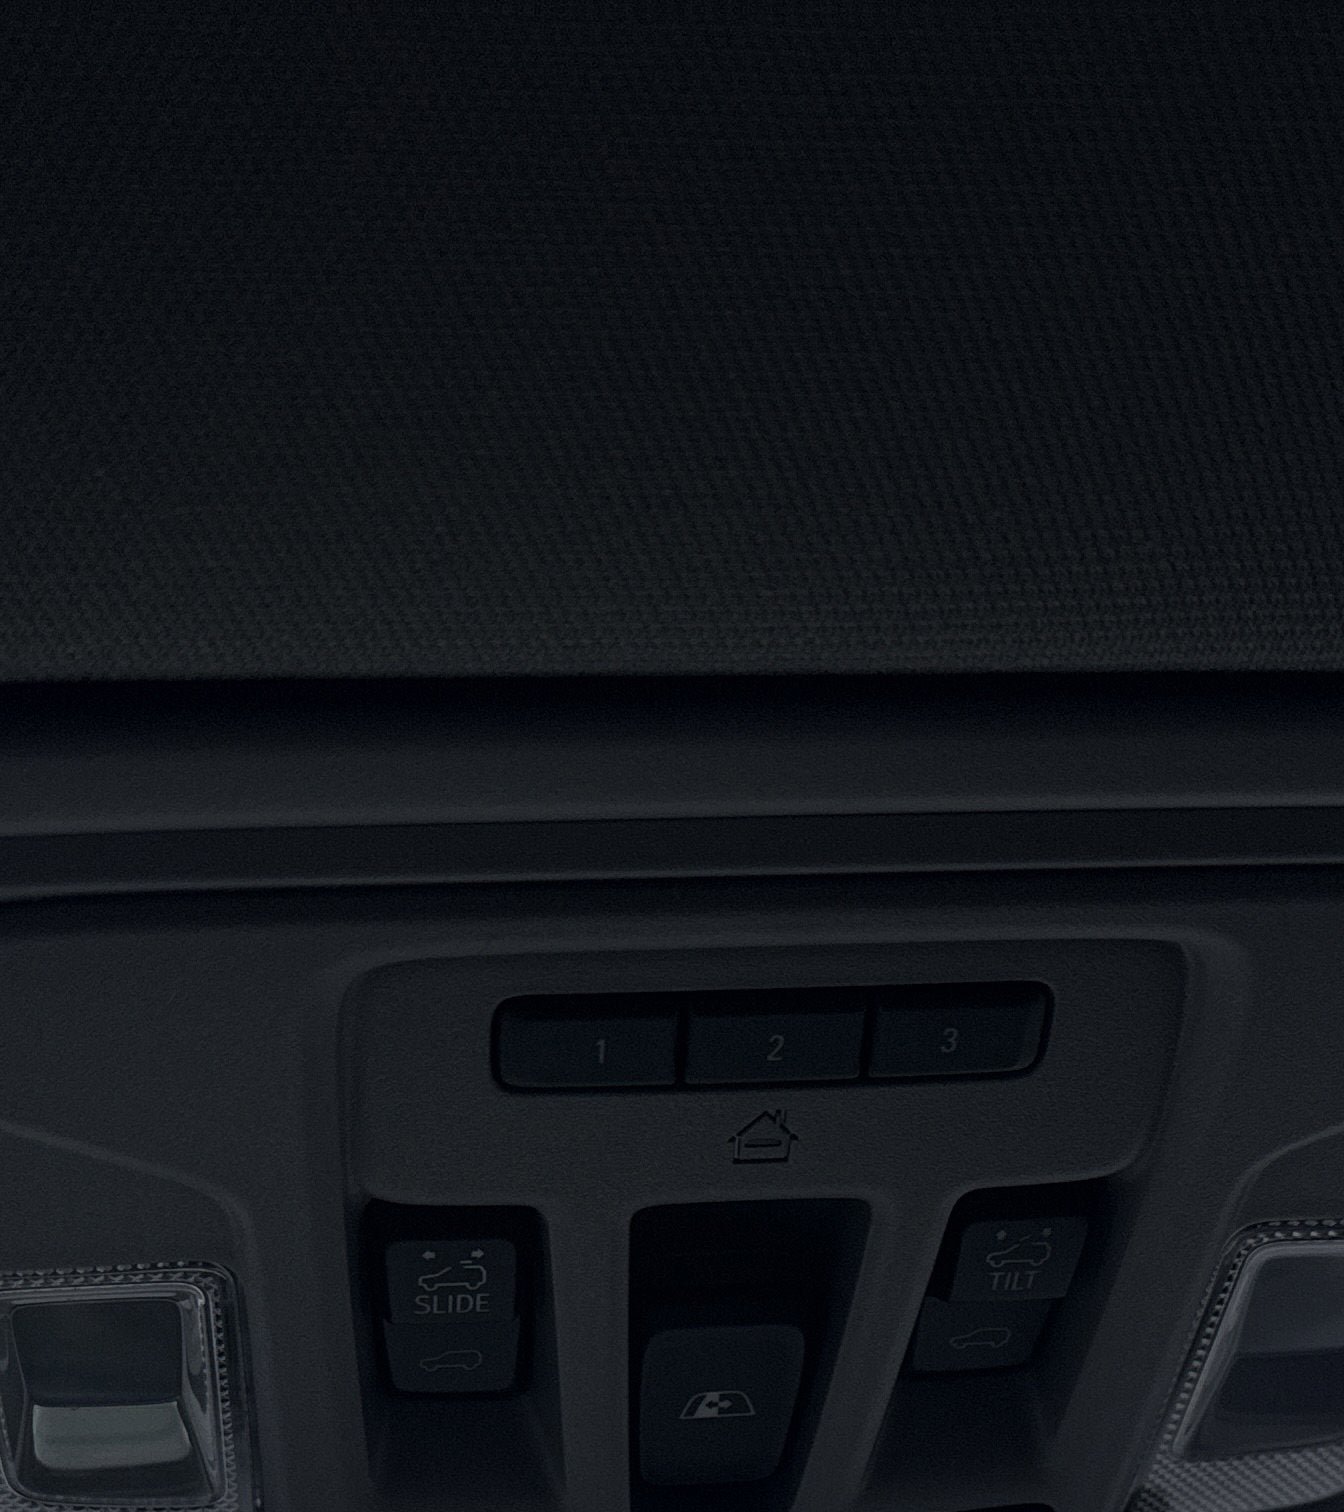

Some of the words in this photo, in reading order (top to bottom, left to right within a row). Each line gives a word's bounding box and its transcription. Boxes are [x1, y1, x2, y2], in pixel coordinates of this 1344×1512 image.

[594, 1038, 606, 1064] 1
[766, 1035, 785, 1062] 2
[940, 1028, 957, 1054] 3
[988, 1270, 1042, 1293] TILT
[413, 1293, 490, 1315] SLIDE
